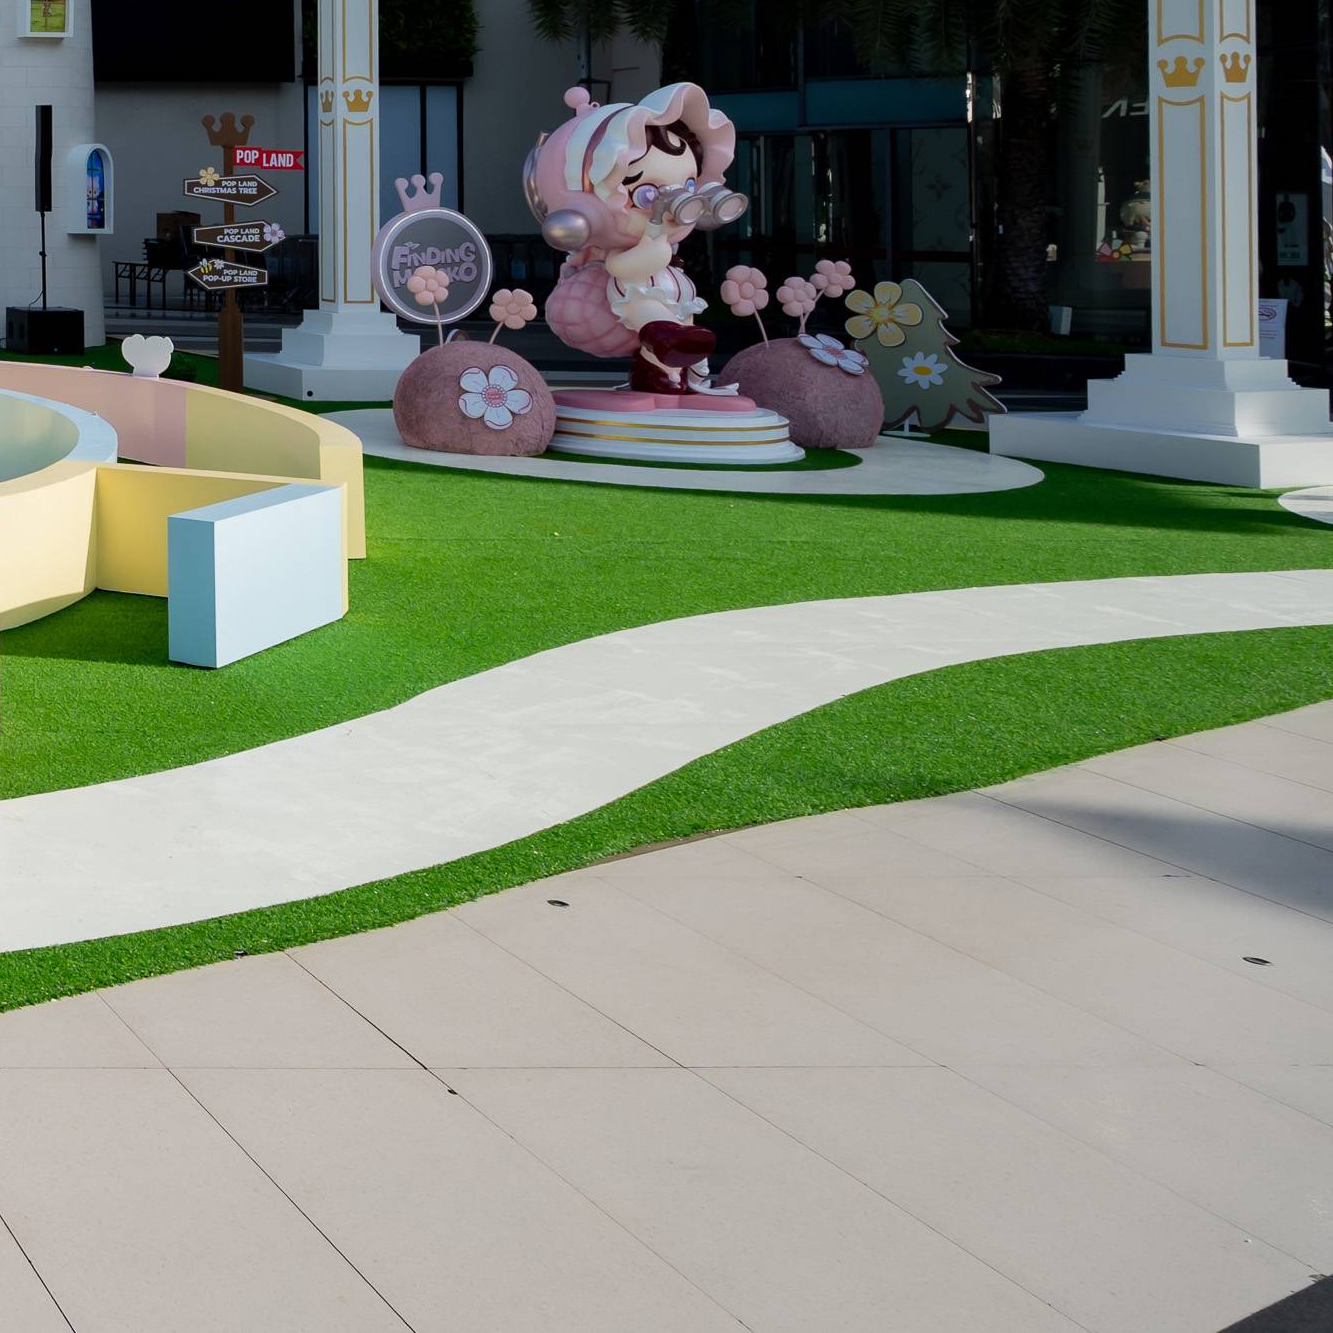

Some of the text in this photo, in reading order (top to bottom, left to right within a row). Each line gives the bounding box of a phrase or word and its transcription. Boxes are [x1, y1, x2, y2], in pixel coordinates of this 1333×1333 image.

[236, 149, 294, 167] POP LAND
[216, 235, 261, 243] CASCADE
[202, 274, 258, 283] POP-UP STORE
